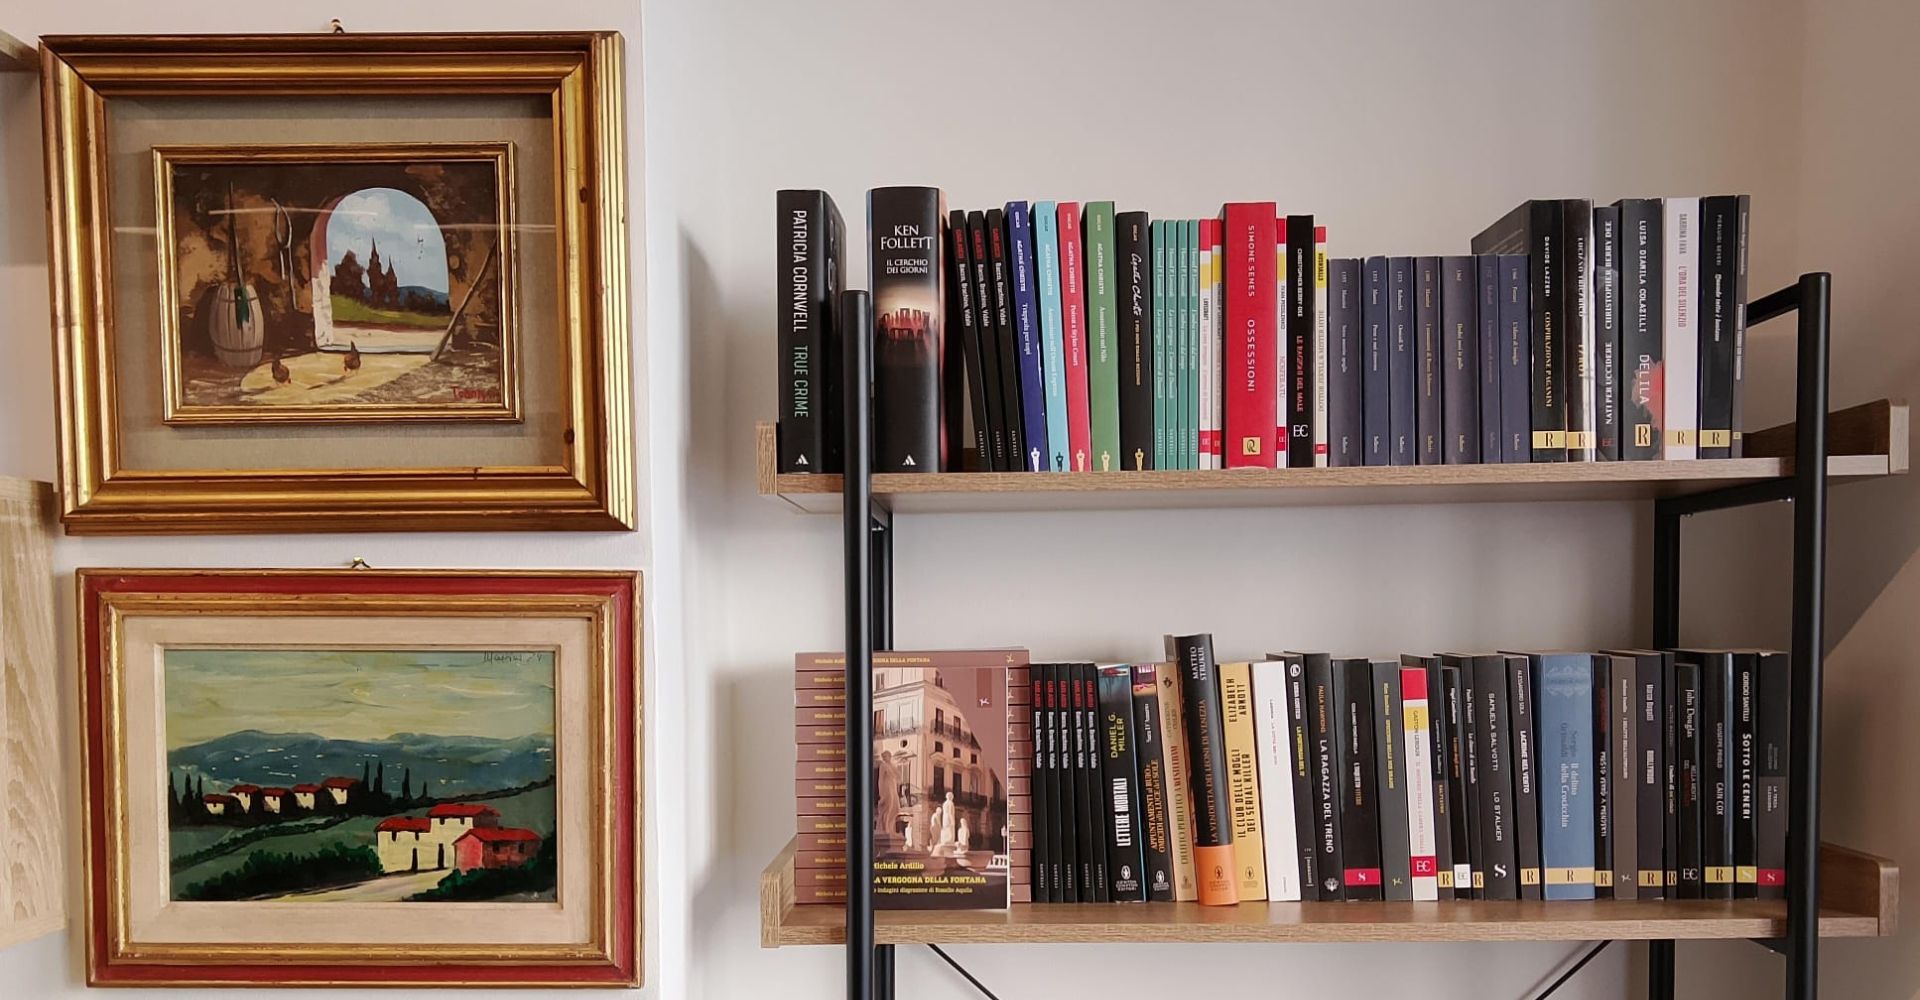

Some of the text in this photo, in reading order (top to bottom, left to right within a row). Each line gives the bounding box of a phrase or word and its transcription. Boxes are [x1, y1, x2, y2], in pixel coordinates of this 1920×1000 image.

[880, 236, 933, 250] FOLLETT
[894, 225, 919, 236] KEN
[1679, 214, 1687, 254] SABRINA FAVA
[792, 210, 808, 332] PATRICIA CORNWELL
[886, 259, 928, 267] IL CERCHIO
[886, 266, 928, 274] DEI GIORNI
[1016, 240, 1026, 292] AGATHA CHRISTIE
[1131, 253, 1143, 318] Agatha Christie
[1678, 266, 1687, 328] L'ORA DEL SILENZIO
[1022, 303, 1030, 331] Trappola
[1247, 319, 1255, 391] OSSESSIONI
[1297, 335, 1303, 344] LE
[794, 345, 808, 418] TRUE CRIME
[1640, 354, 1650, 405] DELILA
[1190, 646, 1199, 679] MATTEO
[1198, 647, 1206, 680] STRUKUL
[1226, 678, 1237, 722] ELIZABETH
[1237, 684, 1246, 715] ARNOTT
[1742, 671, 1750, 722] GIORGIO SANTELLI
[1199, 699, 1208, 734] VENEZIA
[1685, 689, 1695, 738] John Douglas
[1108, 712, 1118, 758] DANIEL G.
[1117, 718, 1125, 751] MILLER
[1202, 736, 1209, 745] DI
[1488, 693, 1498, 771] SAMUELA SALVOTTI
[1520, 730, 1528, 758] LACRIME
[1570, 730, 1578, 756] Sergio
[1151, 760, 1159, 780] SOLE
[1204, 747, 1212, 772] LEONI
[1231, 748, 1240, 775] MOGLI
[1743, 769, 1750, 780] LE
[1155, 791, 1163, 810] LUCE
[1233, 779, 1243, 803] DELLE
[1242, 754, 1256, 832] DEI SERIAL KILLER
[1320, 739, 1334, 853] LA RAGAZZA DEL TRENO
[1561, 764, 1569, 827] della Crocicchia
[1716, 782, 1724, 815] CAIN COX
[1742, 783, 1750, 819] CENERI
[1113, 778, 1131, 846] LETTERE MORTALI
[1144, 768, 1158, 849] APPUNTAMENTI BUIO
[1175, 794, 1186, 831] PERFETTO
[1206, 790, 1216, 832] VENDETTA
[1236, 807, 1244, 827] CLUB
[1494, 792, 1502, 841] LO STALKER
[1157, 823, 1165, 853] OMICIDI
[1179, 832, 1189, 864] DELITTO
[1211, 833, 1218, 843] LA
